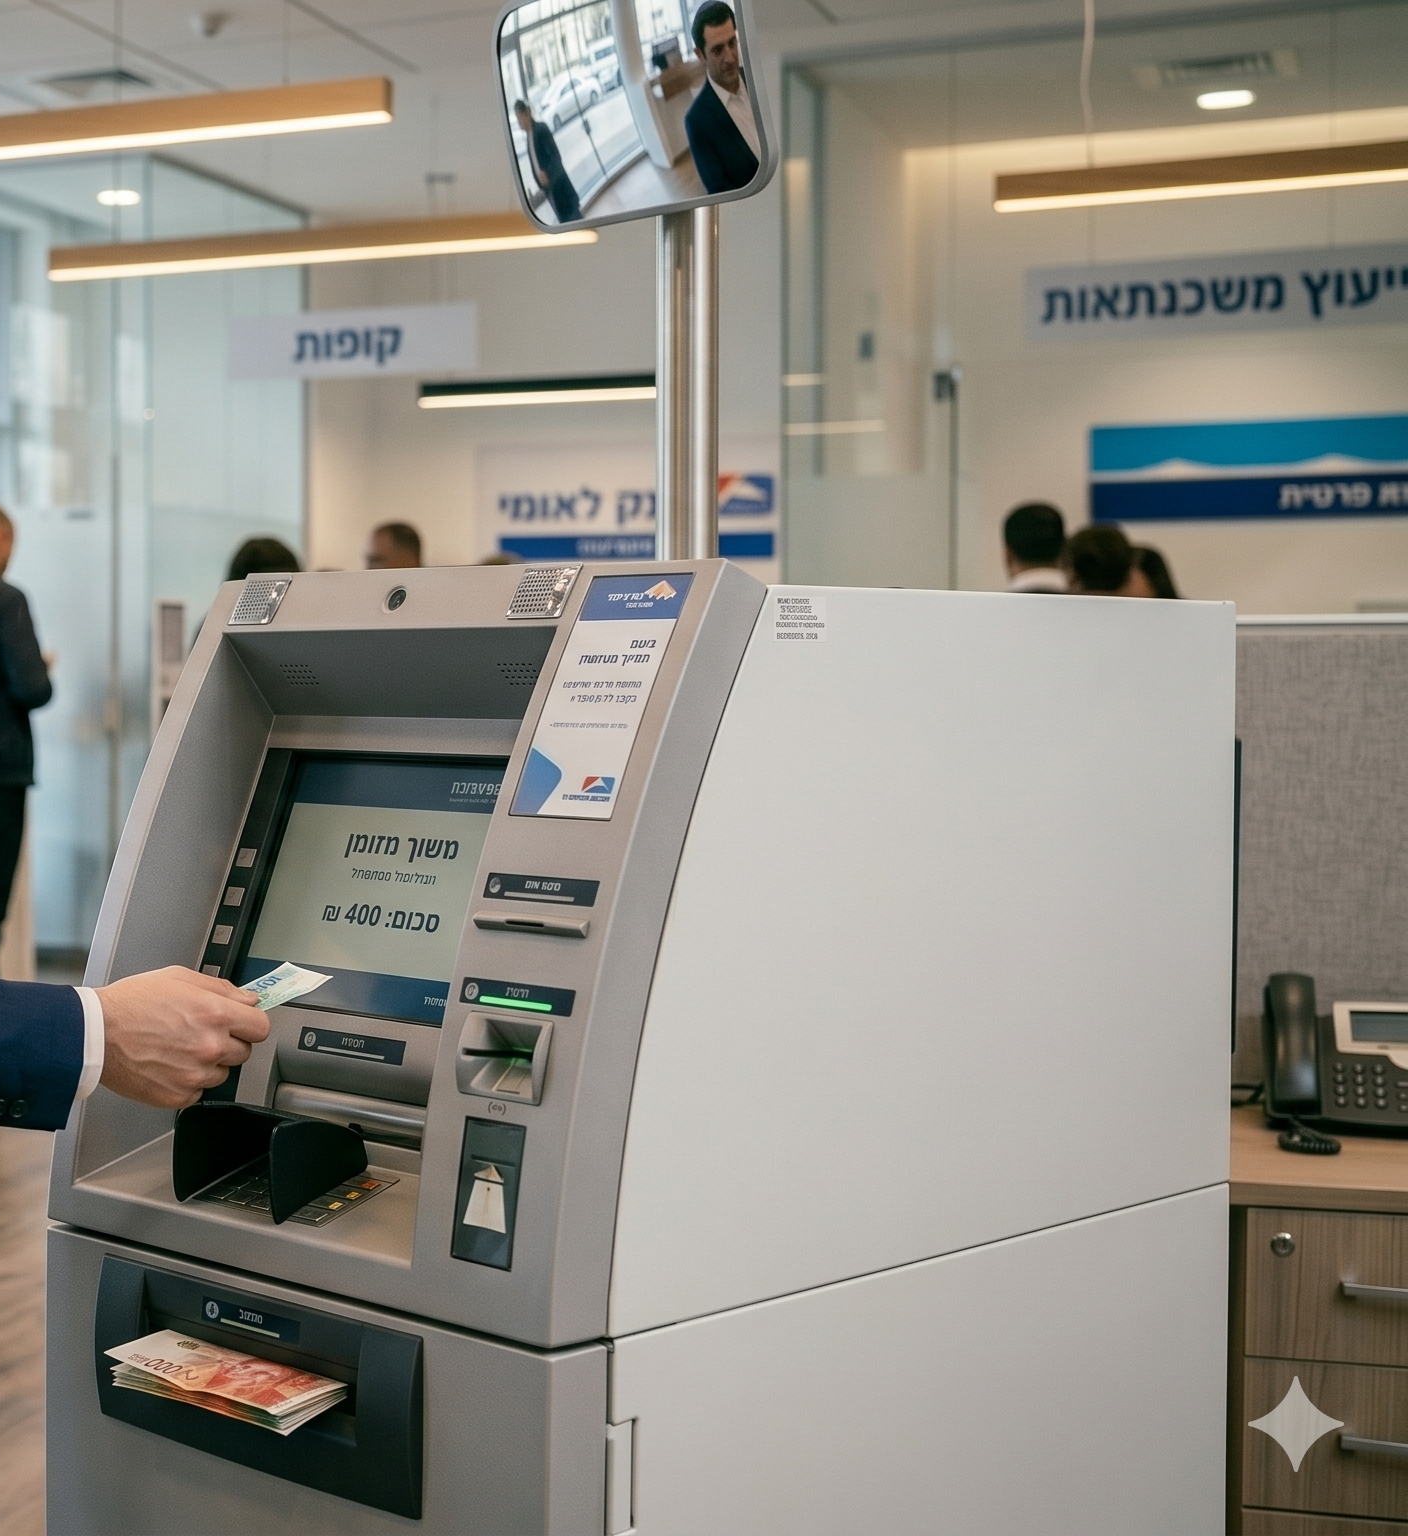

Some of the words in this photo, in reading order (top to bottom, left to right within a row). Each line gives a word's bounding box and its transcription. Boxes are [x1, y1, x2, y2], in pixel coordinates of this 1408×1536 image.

[1041, 273, 1285, 324] משכנתאות
[293, 325, 403, 366] קופות
[498, 485, 602, 522] לאומי
[344, 833, 400, 858] מזומן
[407, 837, 460, 863] משוך
[344, 903, 382, 926] 400
[384, 910, 440, 933] סכום:
